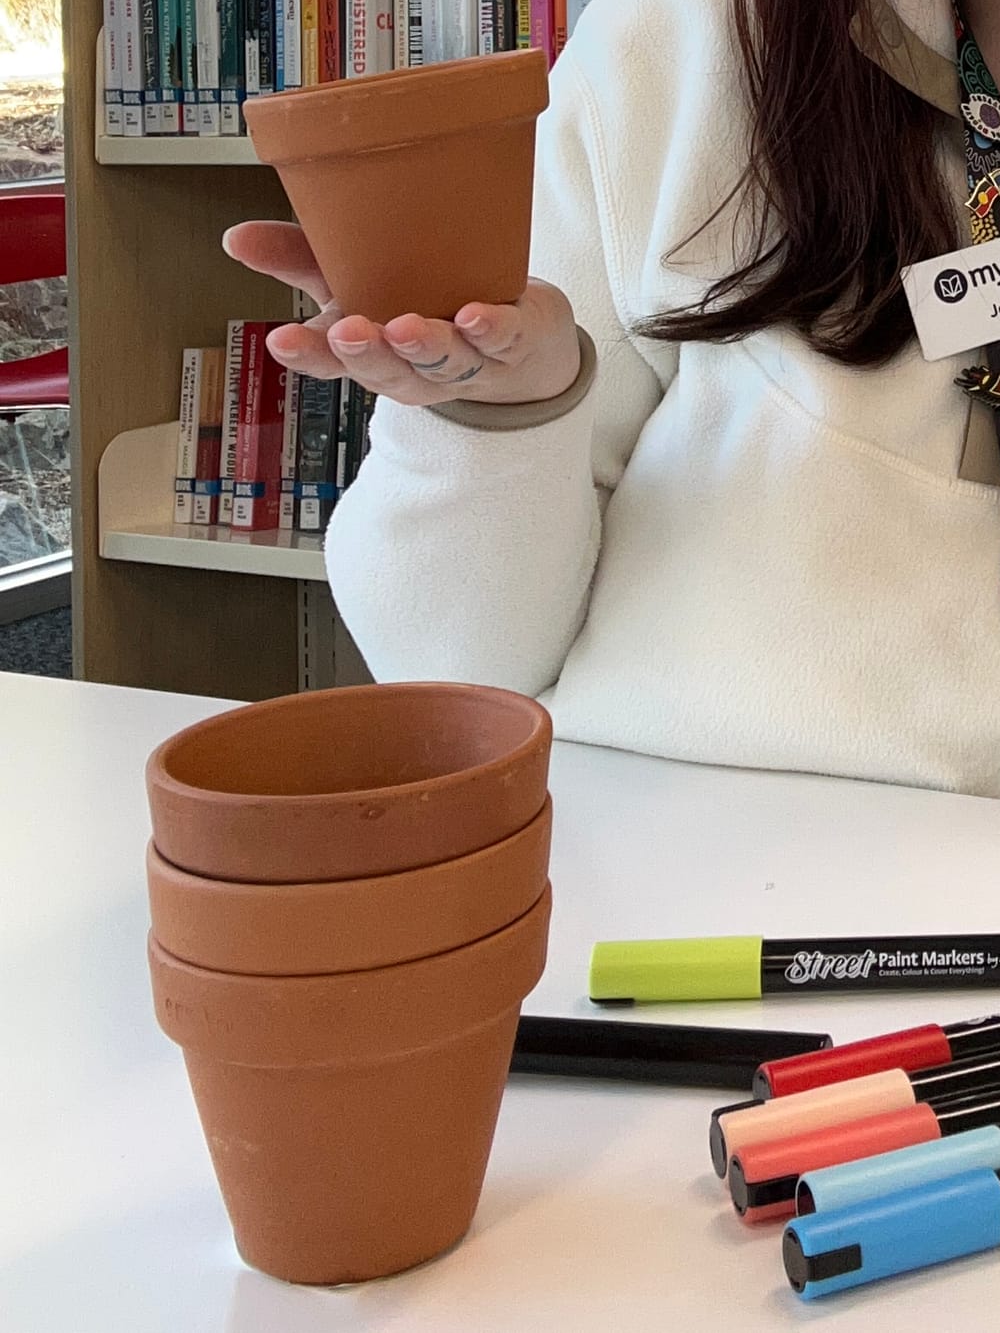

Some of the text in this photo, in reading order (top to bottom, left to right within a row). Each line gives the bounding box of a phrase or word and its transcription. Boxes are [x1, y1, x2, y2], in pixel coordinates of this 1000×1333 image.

[261, 10, 270, 27] We
[261, 30, 270, 53] Saw
[409, 25, 423, 51] DAVID
[228, 399, 239, 439] ALBERT
[784, 948, 877, 985] Street
[878, 950, 919, 968] Paint
[921, 949, 985, 967] Markers
[986, 952, 998, 969] by
[877, 967, 901, 977] Create,
[901, 967, 923, 977] Colour
[930, 967, 948, 976] Cover
[948, 966, 985, 977] Everything!
